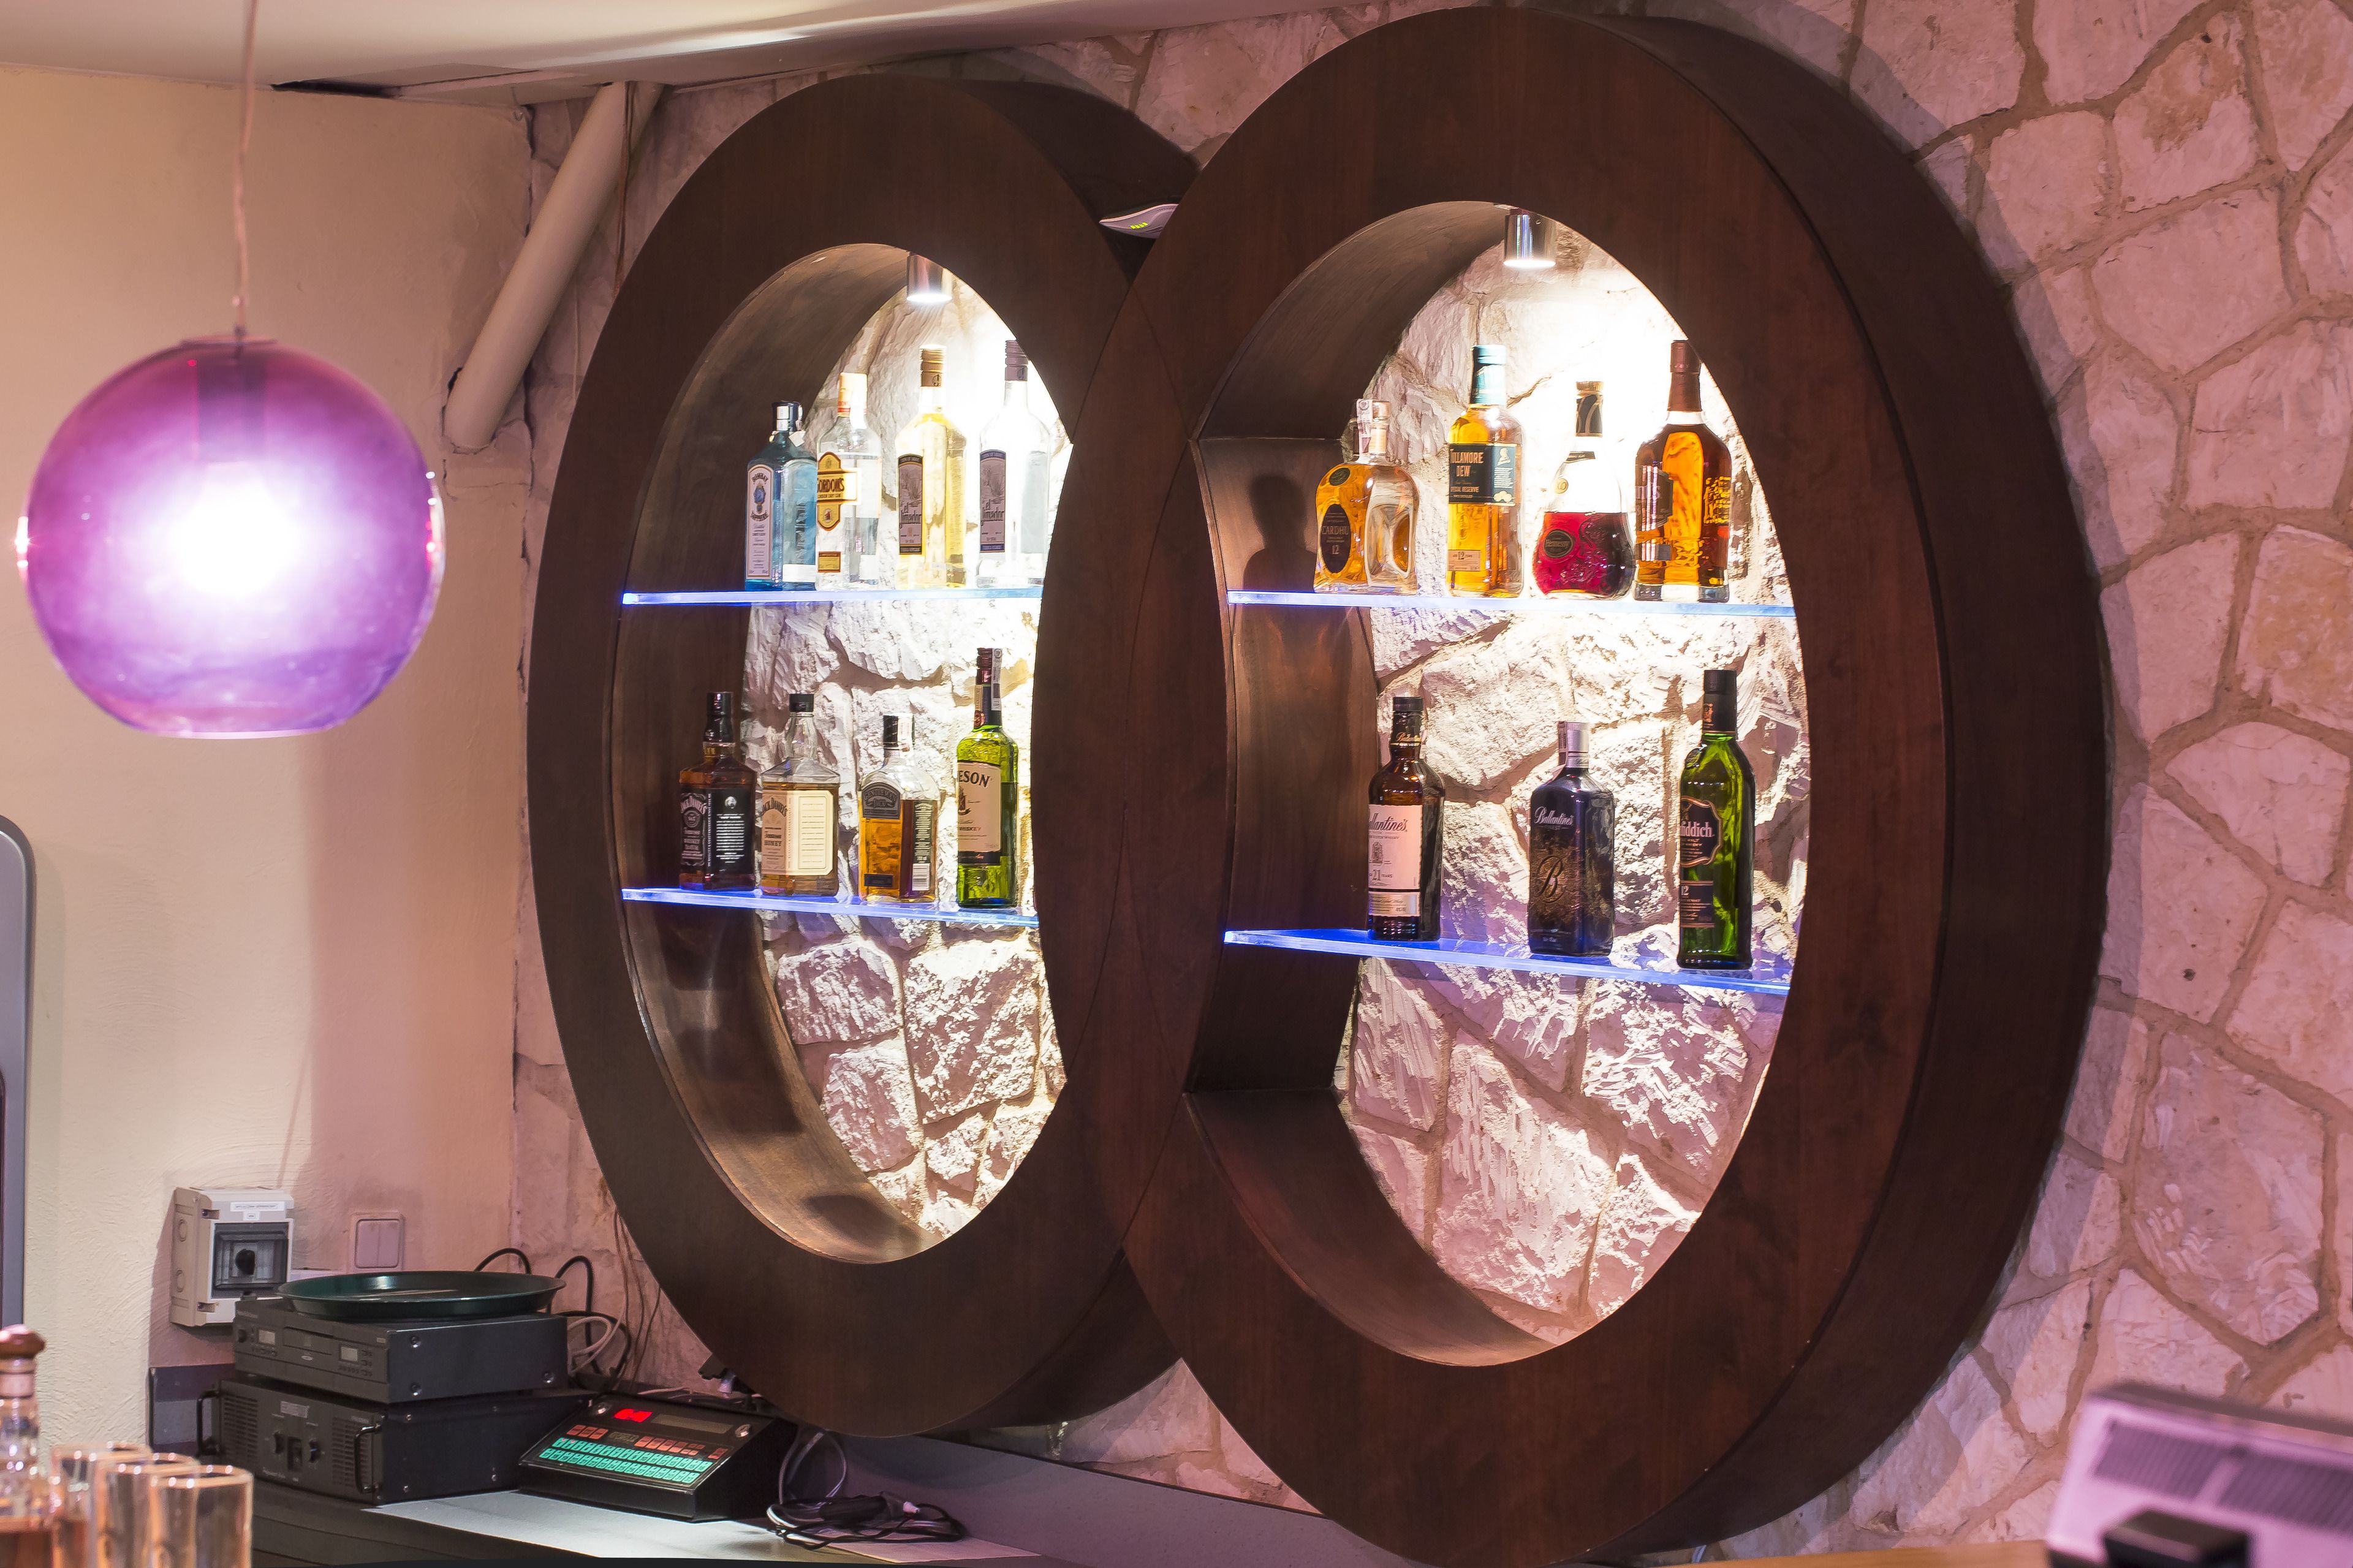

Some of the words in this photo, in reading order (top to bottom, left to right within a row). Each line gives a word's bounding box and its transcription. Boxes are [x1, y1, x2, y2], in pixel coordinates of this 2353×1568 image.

[1450, 449, 1484, 464] TULLAMORE
[1456, 465, 1471, 477] DEW
[752, 472, 768, 483] BOMBAY
[903, 502, 909, 513] el
[985, 499, 990, 510] el
[1322, 526, 1349, 535] CARDHU
[1332, 545, 1339, 555] 12
[1534, 806, 1574, 826] Ballantine's
[1372, 869, 1381, 881] 21
[1681, 885, 1689, 896] 12
